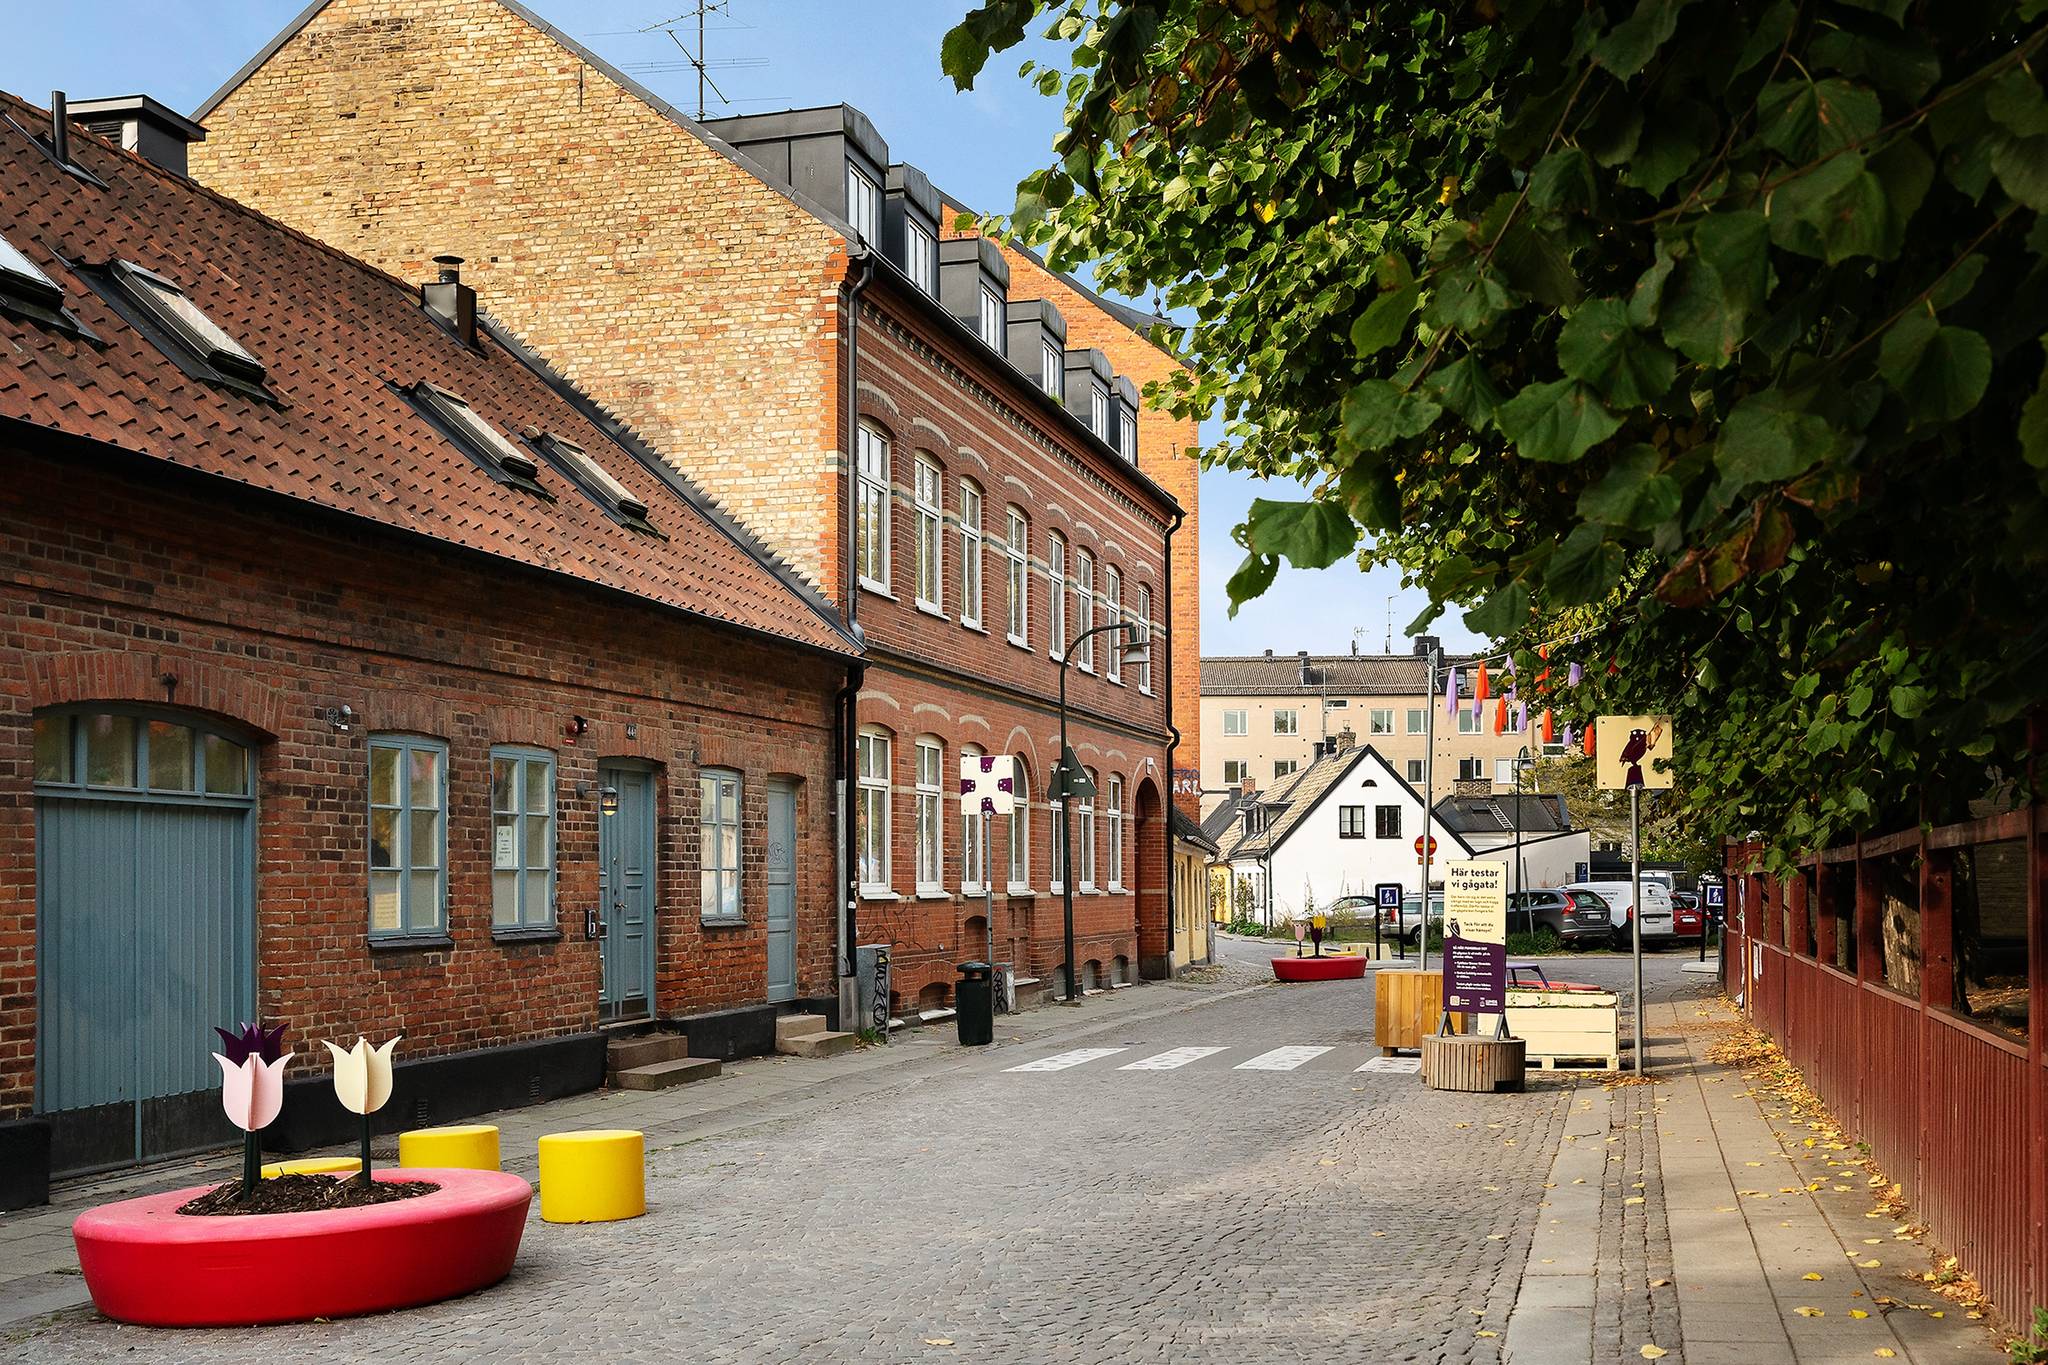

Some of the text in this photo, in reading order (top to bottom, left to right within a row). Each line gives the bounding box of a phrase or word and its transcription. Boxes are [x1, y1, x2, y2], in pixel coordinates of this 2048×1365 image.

[1451, 867, 1499, 877] Här testar
[1581, 863, 1587, 874] P
[1451, 879, 1498, 891] vi gågata!
